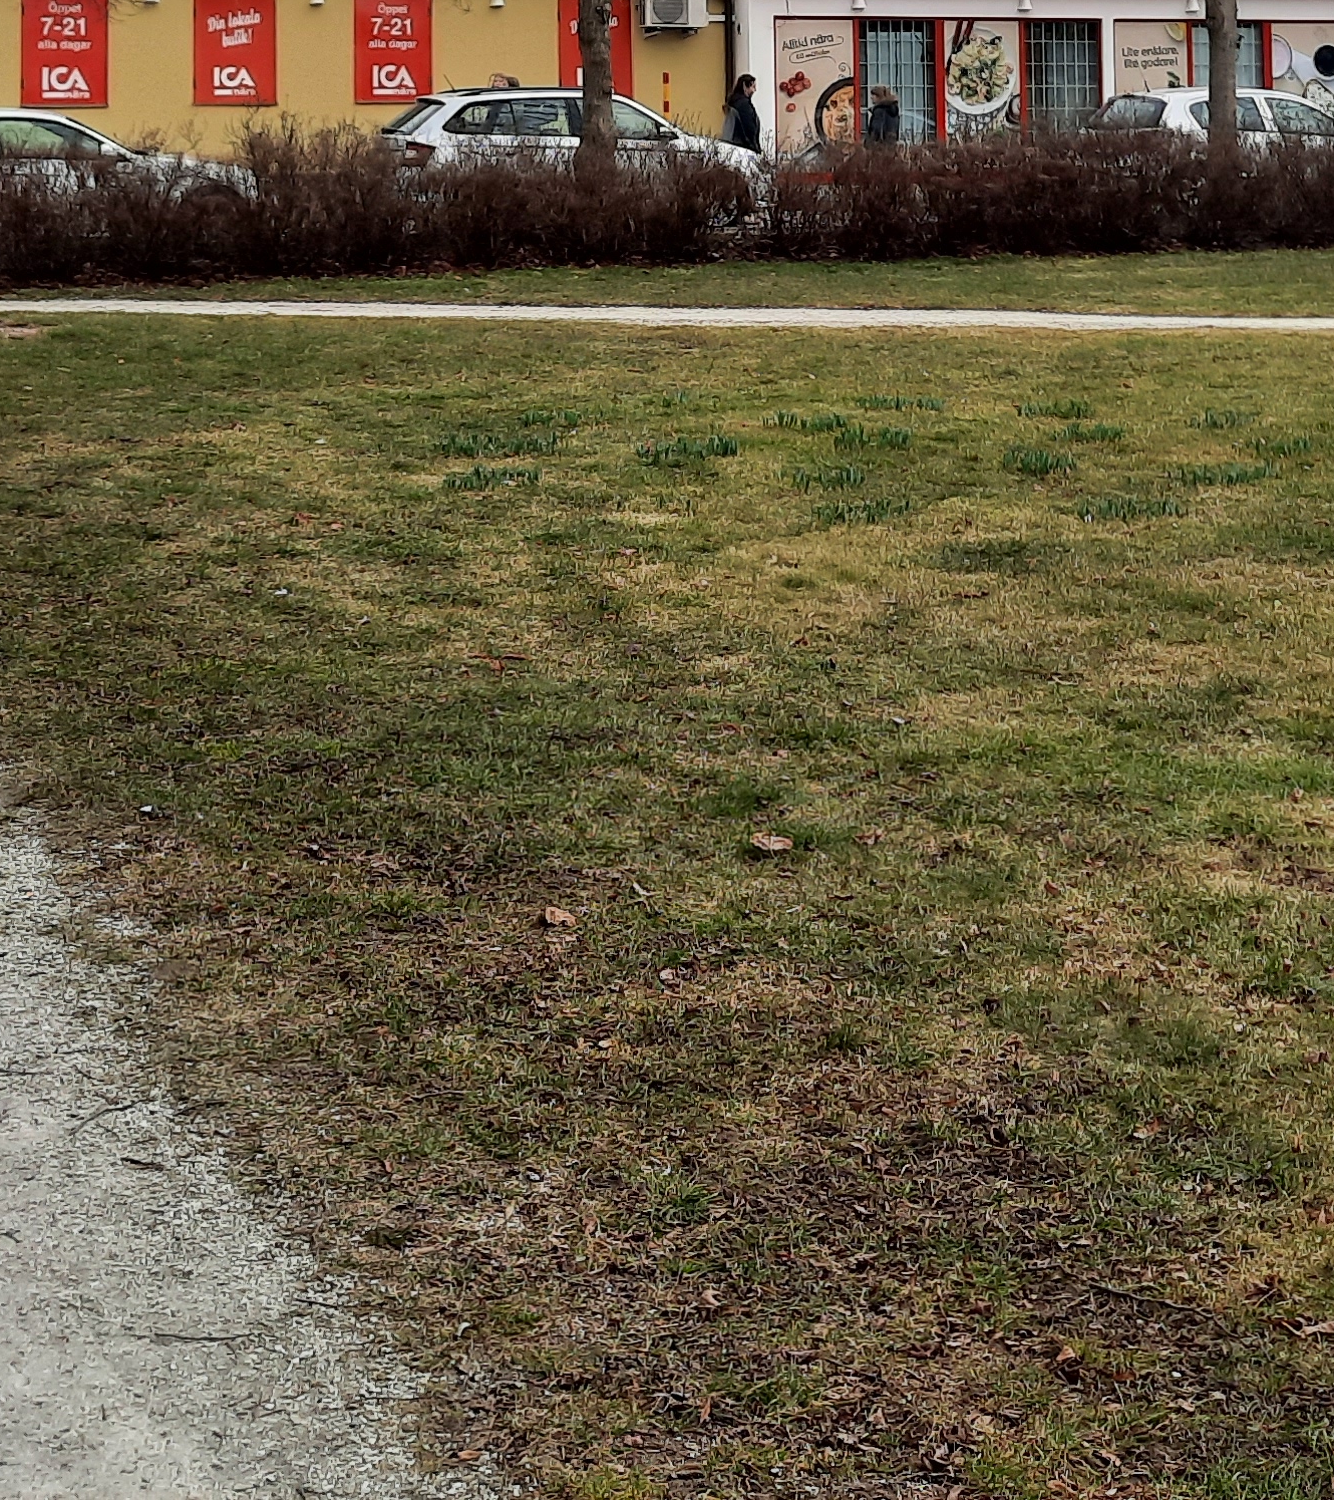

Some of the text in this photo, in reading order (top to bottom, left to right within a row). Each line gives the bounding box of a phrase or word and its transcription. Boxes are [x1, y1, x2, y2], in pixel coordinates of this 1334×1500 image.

[48, 0, 82, 16] Öppet
[228, 7, 261, 29] lokala
[377, 2, 409, 16] Öppet
[40, 16, 86, 37] 7-21
[370, 17, 412, 36] 7-21
[37, 40, 92, 52] alla dagar
[369, 39, 418, 50] alla dagar
[41, 66, 89, 91] ICA
[213, 66, 256, 87] ICA
[372, 64, 416, 88] ICA
